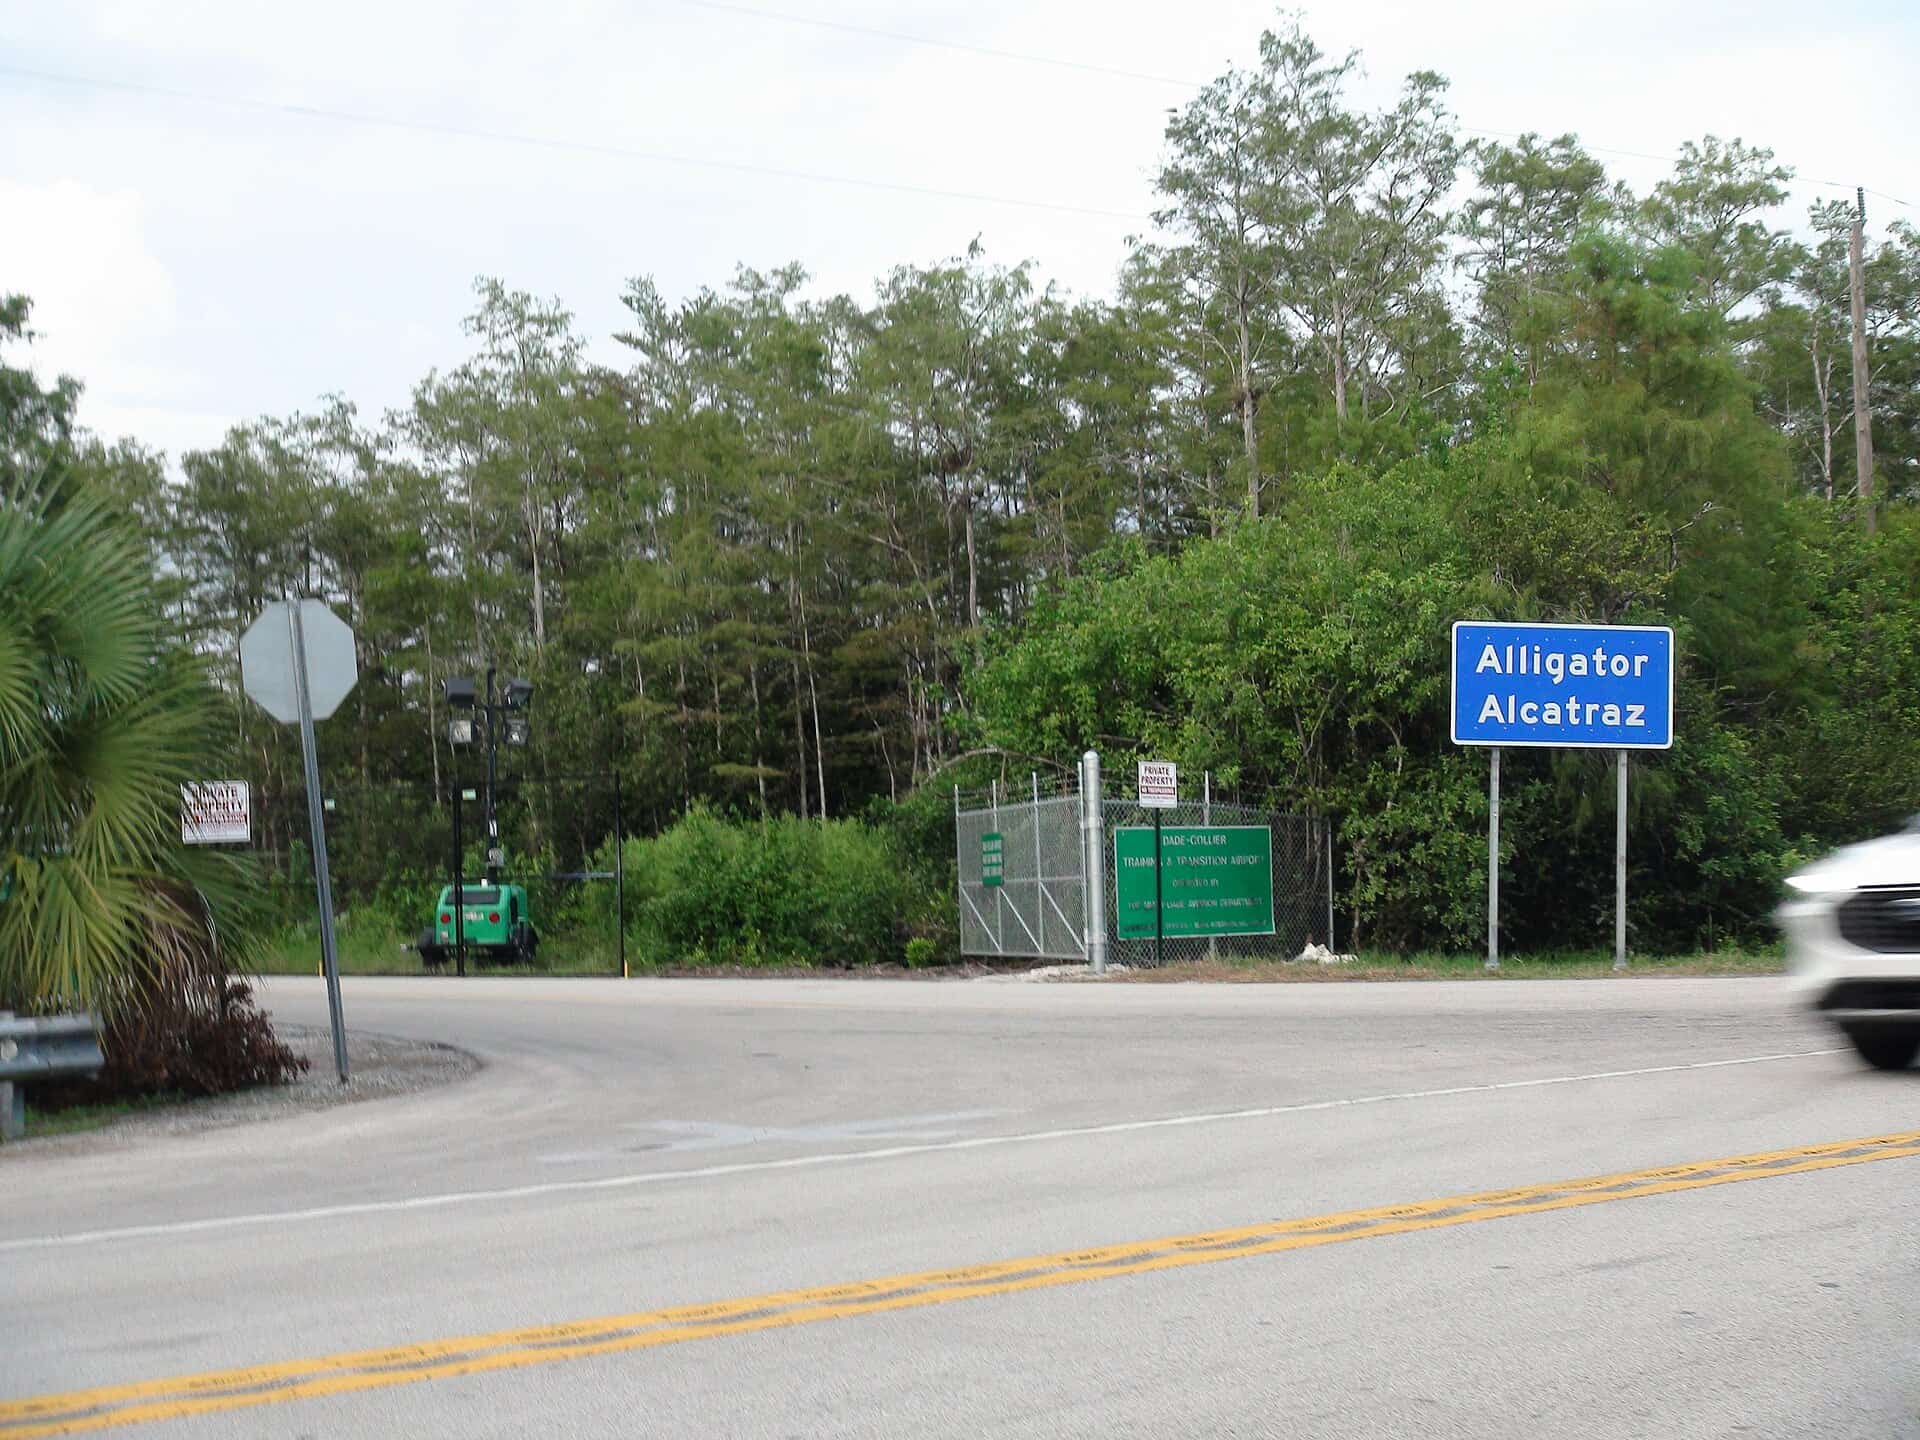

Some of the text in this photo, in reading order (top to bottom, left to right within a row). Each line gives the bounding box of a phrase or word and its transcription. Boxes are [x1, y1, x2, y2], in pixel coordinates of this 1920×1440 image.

[1475, 644, 1649, 685] Alligator
[1477, 694, 1646, 727] Alcatraz
[1144, 765, 1170, 776] PRIVATE
[1141, 775, 1173, 785] PROPERTY
[1162, 834, 1227, 846] DADE-COLLIER
[1123, 856, 1163, 867] TRAININ
[1176, 854, 1227, 867] TRANSITION
